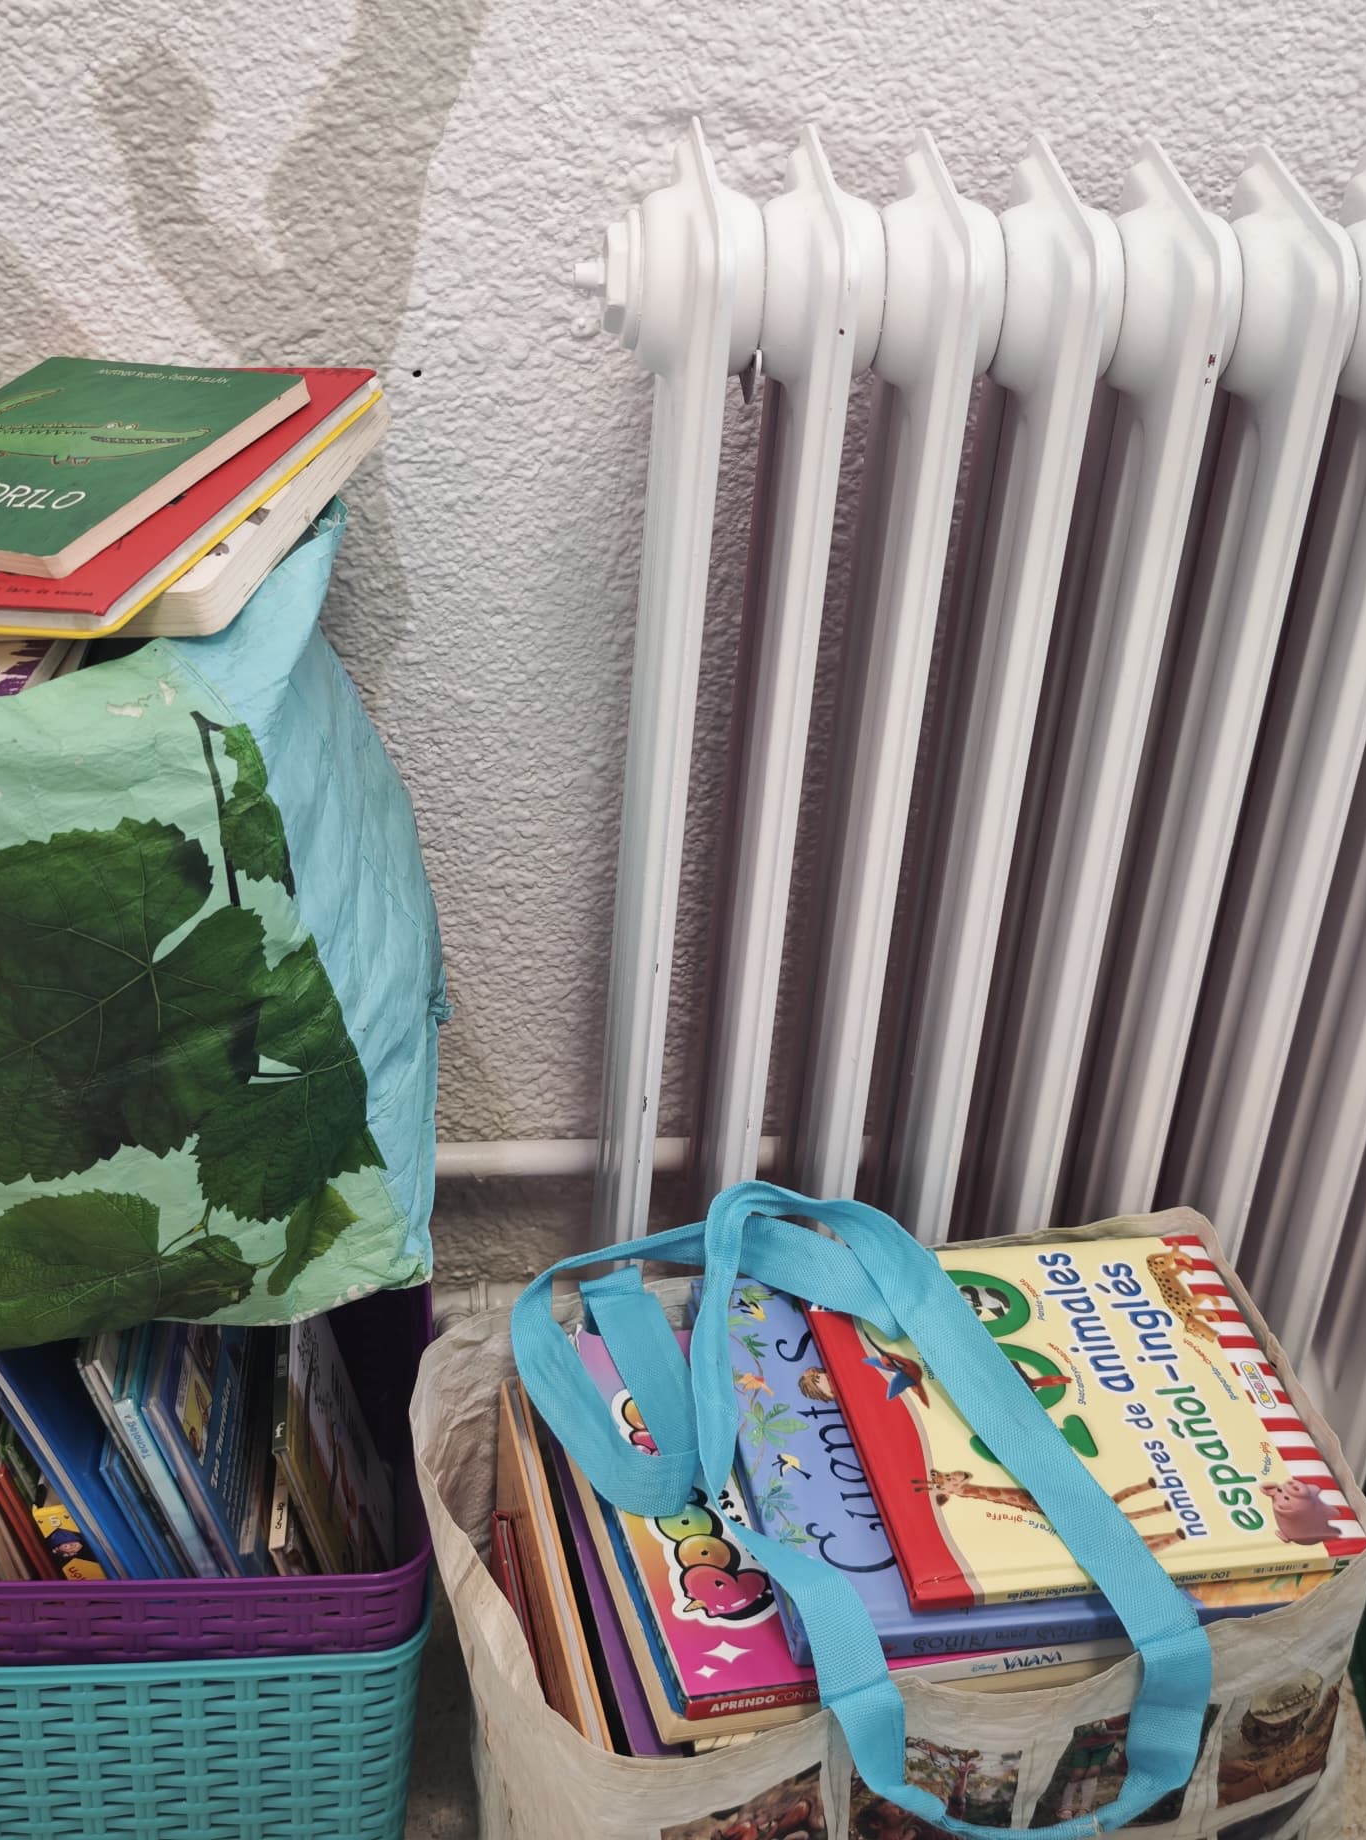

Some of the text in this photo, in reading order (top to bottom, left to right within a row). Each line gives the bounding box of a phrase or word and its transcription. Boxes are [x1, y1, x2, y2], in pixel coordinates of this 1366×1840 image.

[1037, 1251, 1208, 1539] nombres de animales
[1002, 1649, 1063, 1671] VAIANA
[709, 1694, 776, 1714] APRENDO
